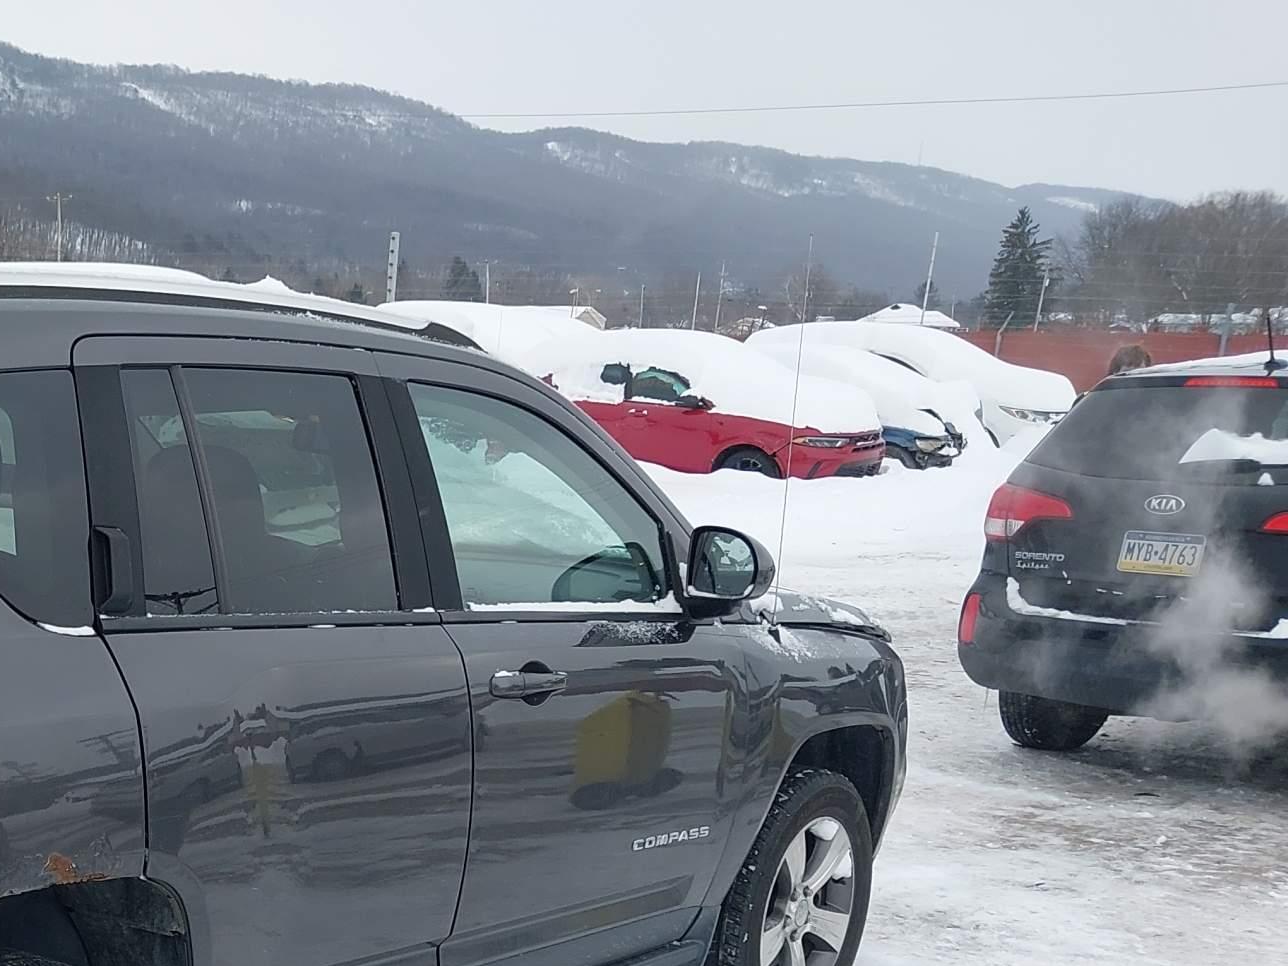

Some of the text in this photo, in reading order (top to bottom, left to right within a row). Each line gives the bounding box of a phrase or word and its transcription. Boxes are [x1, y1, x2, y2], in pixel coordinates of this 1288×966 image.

[1150, 499, 1177, 510] KIA
[1015, 551, 1065, 562] SORENTO
[632, 826, 710, 851] COMPASS
